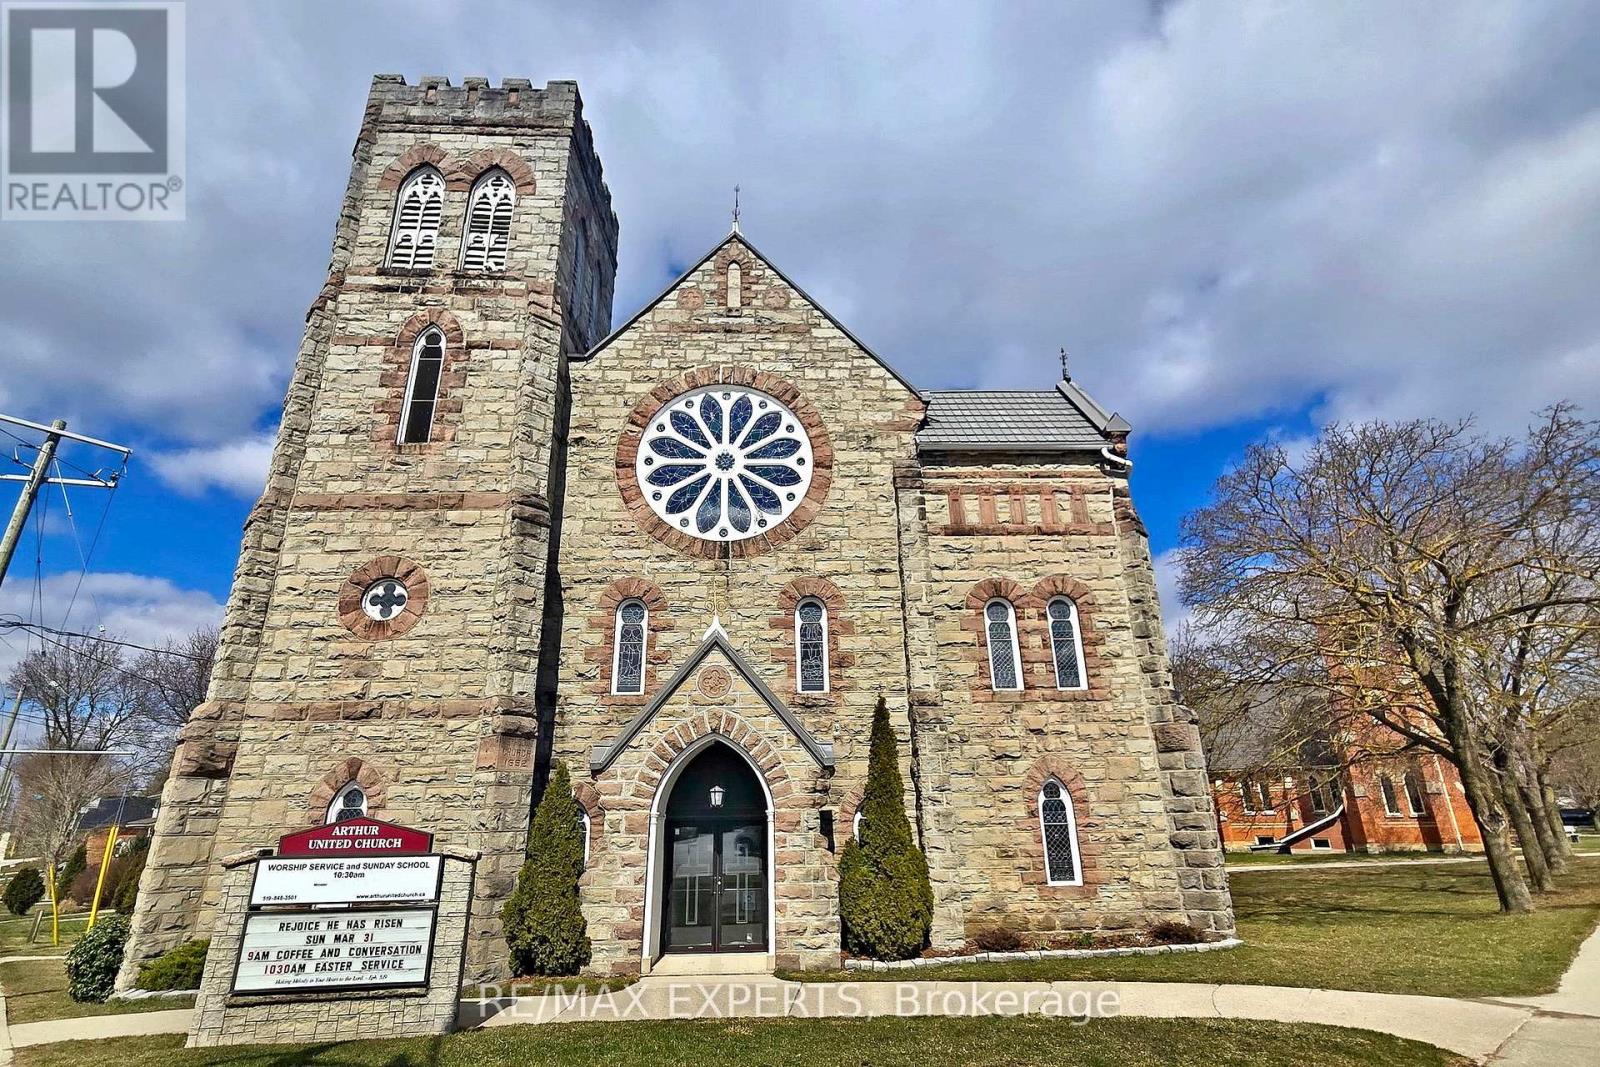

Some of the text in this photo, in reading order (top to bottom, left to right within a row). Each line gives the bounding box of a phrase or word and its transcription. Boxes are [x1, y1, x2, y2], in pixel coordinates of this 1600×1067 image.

[331, 825, 380, 836] ARTHUR
[308, 838, 402, 850] UNITED CHURCH
[267, 861, 430, 871] WORSHIP SERVICE and SUNDAY SCHOOL
[333, 871, 365, 879] 10:30am
[278, 918, 403, 932] REJOICE HE HAS RISEN
[306, 933, 374, 944] SUN MAR 31
[247, 945, 422, 961] 9AM COFFEE AND CONVERSATION
[263, 959, 404, 975] 1030AM EASTER SERVICE
